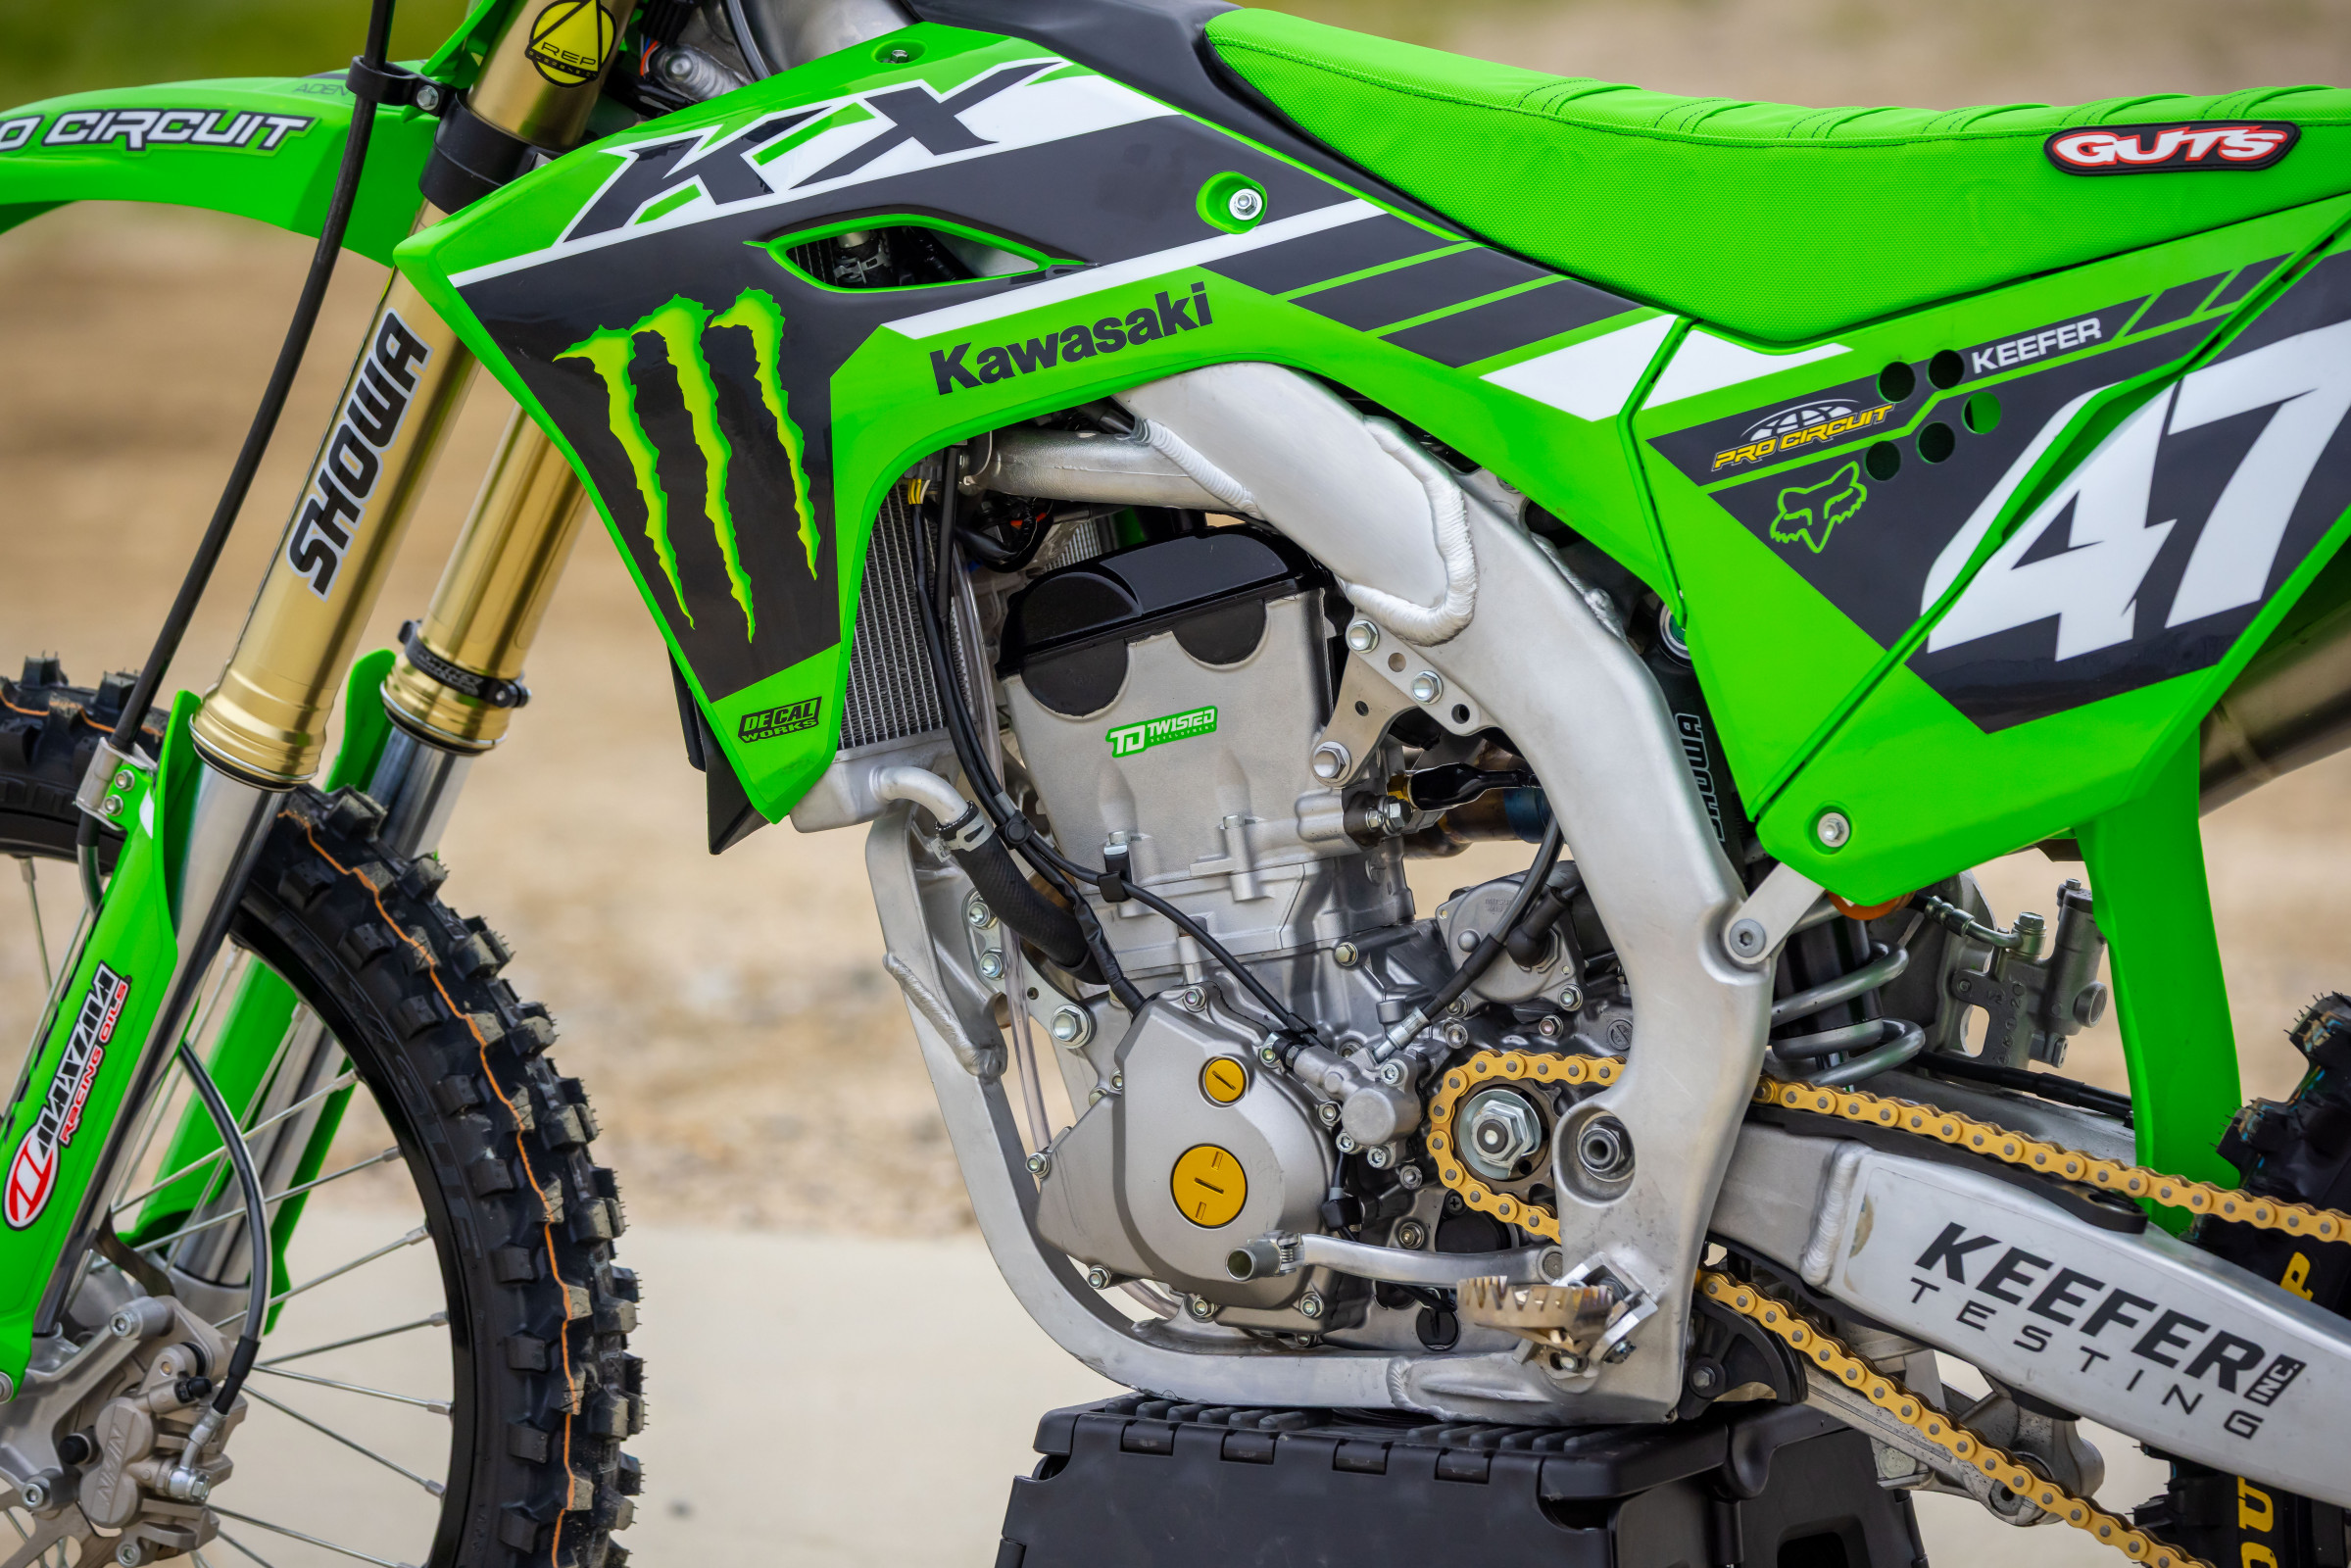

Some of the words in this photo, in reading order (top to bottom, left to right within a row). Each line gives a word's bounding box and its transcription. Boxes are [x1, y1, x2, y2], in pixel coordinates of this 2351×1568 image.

[541, 42, 596, 66] REP
[43, 110, 315, 152] CIRCUIT
[563, 61, 1064, 243] KX
[2054, 126, 2287, 167] GUTS
[929, 282, 1214, 396] Kawasaki
[1972, 318, 2102, 374] KEEFER
[289, 311, 430, 597] SHOWA
[1713, 438, 1778, 470] PRO
[1779, 404, 1894, 451] CIRCUIT
[1921, 320, 2351, 662] 47
[741, 718, 817, 742] WORKS
[743, 701, 817, 732] DECAL
[1148, 709, 1215, 737] TWISTED
[99, 979, 128, 1044] OILS
[1915, 1222, 2266, 1395] KEEFER
[2248, 1360, 2303, 1405] INC.
[1910, 1276, 2265, 1439] TESTING
